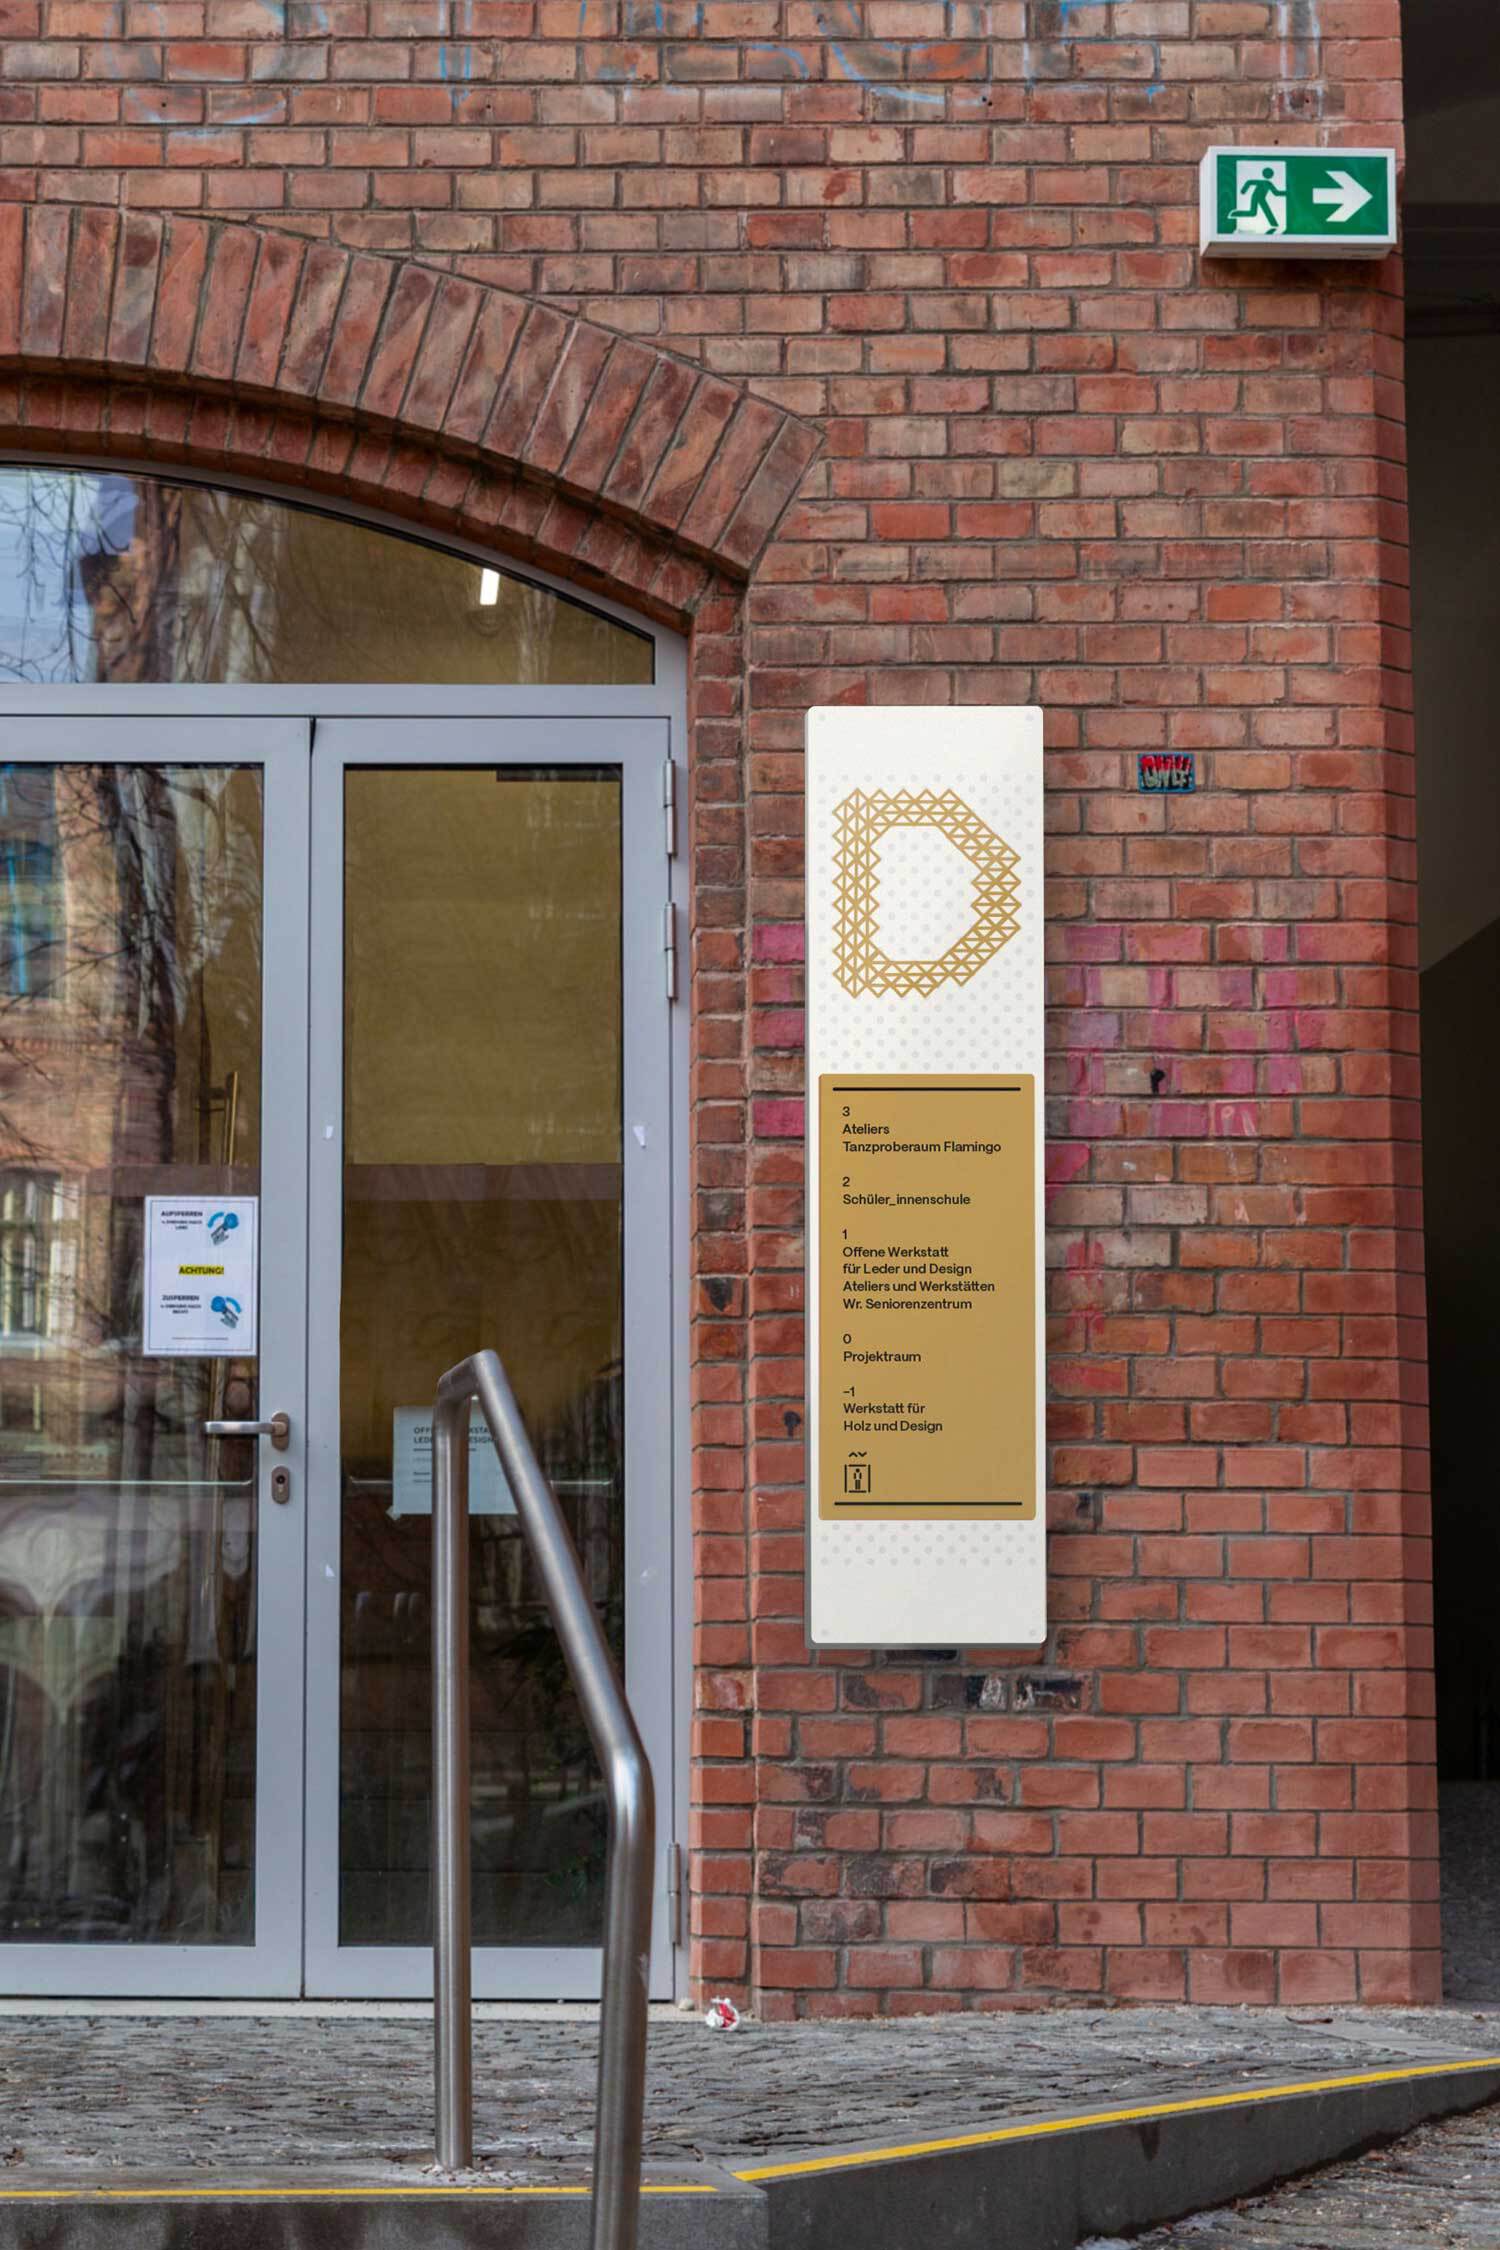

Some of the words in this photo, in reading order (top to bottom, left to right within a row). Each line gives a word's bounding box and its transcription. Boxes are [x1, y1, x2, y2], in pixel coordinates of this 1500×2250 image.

[842, 1105, 851, 1117] 3
[842, 1123, 890, 1135] Ateliers
[842, 1140, 941, 1155] Tanzproberaum
[943, 1140, 1002, 1155] Flamingo
[842, 1176, 851, 1188] 2
[842, 1193, 971, 1207] Schüler_innenschule
[841, 1228, 849, 1240] 1
[842, 1246, 886, 1258] Offene
[887, 1246, 949, 1258] Werkstatt
[178, 1266, 225, 1275] ACHTUNG!
[842, 1262, 862, 1277] für
[863, 1262, 901, 1277] Leder
[902, 1262, 927, 1277] und
[929, 1262, 972, 1277] Design
[842, 1280, 891, 1292] Ateliers
[892, 1280, 917, 1292] und
[918, 1280, 995, 1292] Werkstätten
[842, 1297, 863, 1310] Wr.
[865, 1297, 973, 1310] Seniorenzentrum
[842, 1333, 852, 1345] 0
[843, 1350, 922, 1365] Projektraum
[842, 1402, 905, 1414] Werkstatt
[906, 1402, 926, 1414] für
[843, 1420, 872, 1434] Holz
[873, 1420, 898, 1434] und
[899, 1420, 943, 1434] Design
